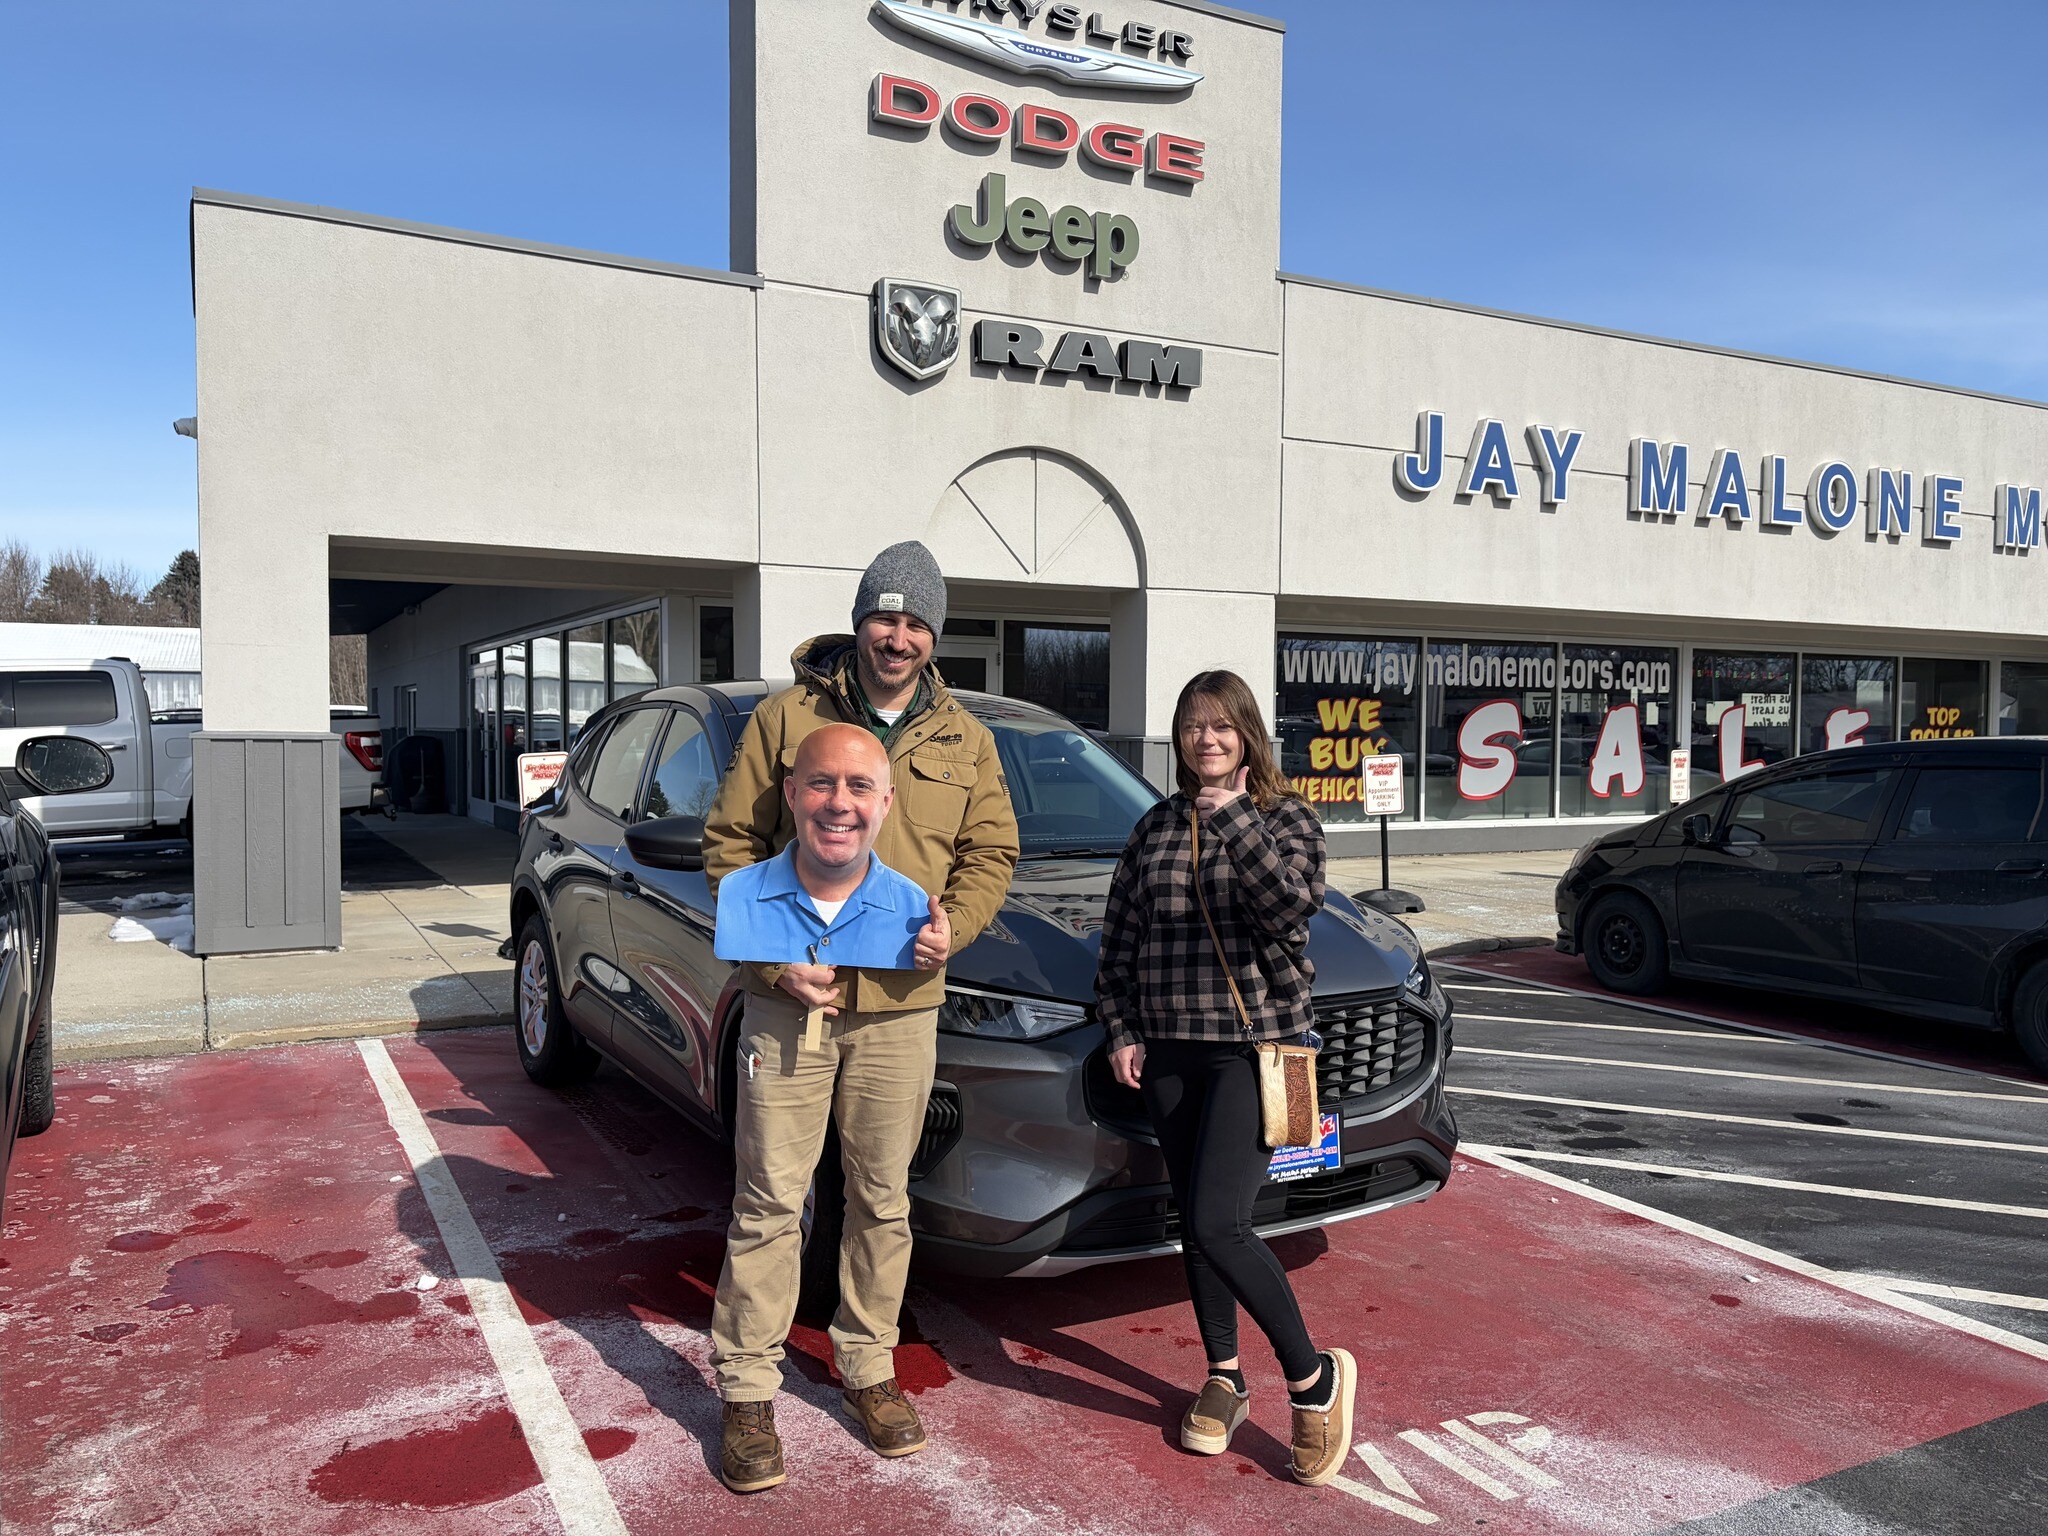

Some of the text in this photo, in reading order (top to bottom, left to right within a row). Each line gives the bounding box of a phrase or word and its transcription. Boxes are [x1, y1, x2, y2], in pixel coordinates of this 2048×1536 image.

[1017, 43, 1080, 62] CHRYSLER
[873, 73, 1206, 183] DODGE
[950, 172, 1140, 280] Jeep
[971, 319, 1203, 388] RAM
[1395, 410, 1585, 504] JAY
[1630, 437, 1965, 542] MALONE
[1282, 643, 1671, 694] www.jaymalonemotors.com
[1317, 697, 1382, 732] WE
[1926, 707, 1961, 727] TOP
